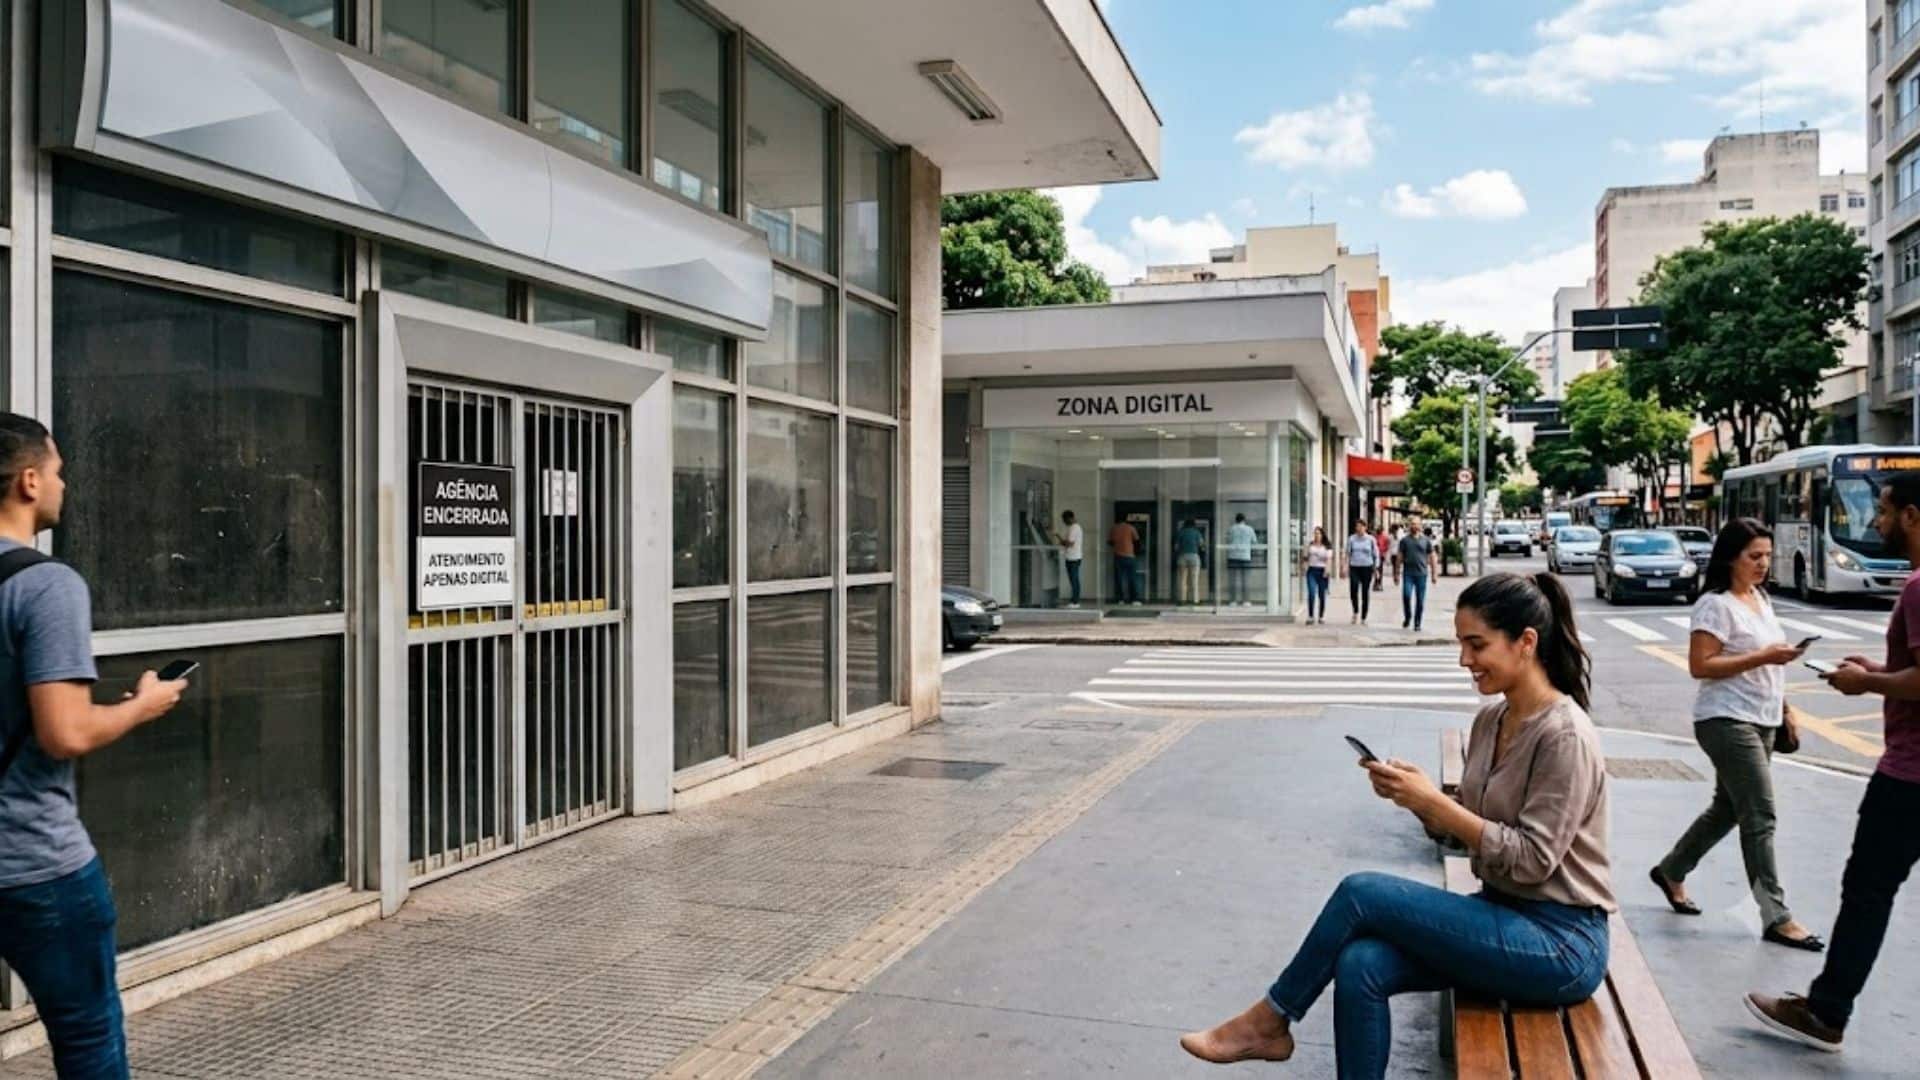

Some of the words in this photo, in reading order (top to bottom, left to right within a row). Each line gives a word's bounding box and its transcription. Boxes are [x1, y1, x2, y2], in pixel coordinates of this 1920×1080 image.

[1057, 396, 1118, 416] ZONA
[1125, 393, 1212, 414] DIGITAL
[435, 478, 499, 502] AGÊNCIA
[424, 506, 509, 525] ENCERRADA
[428, 552, 505, 567] ATENDIMENTO
[423, 572, 467, 587] APENAS
[470, 570, 509, 584] DIGITAL
